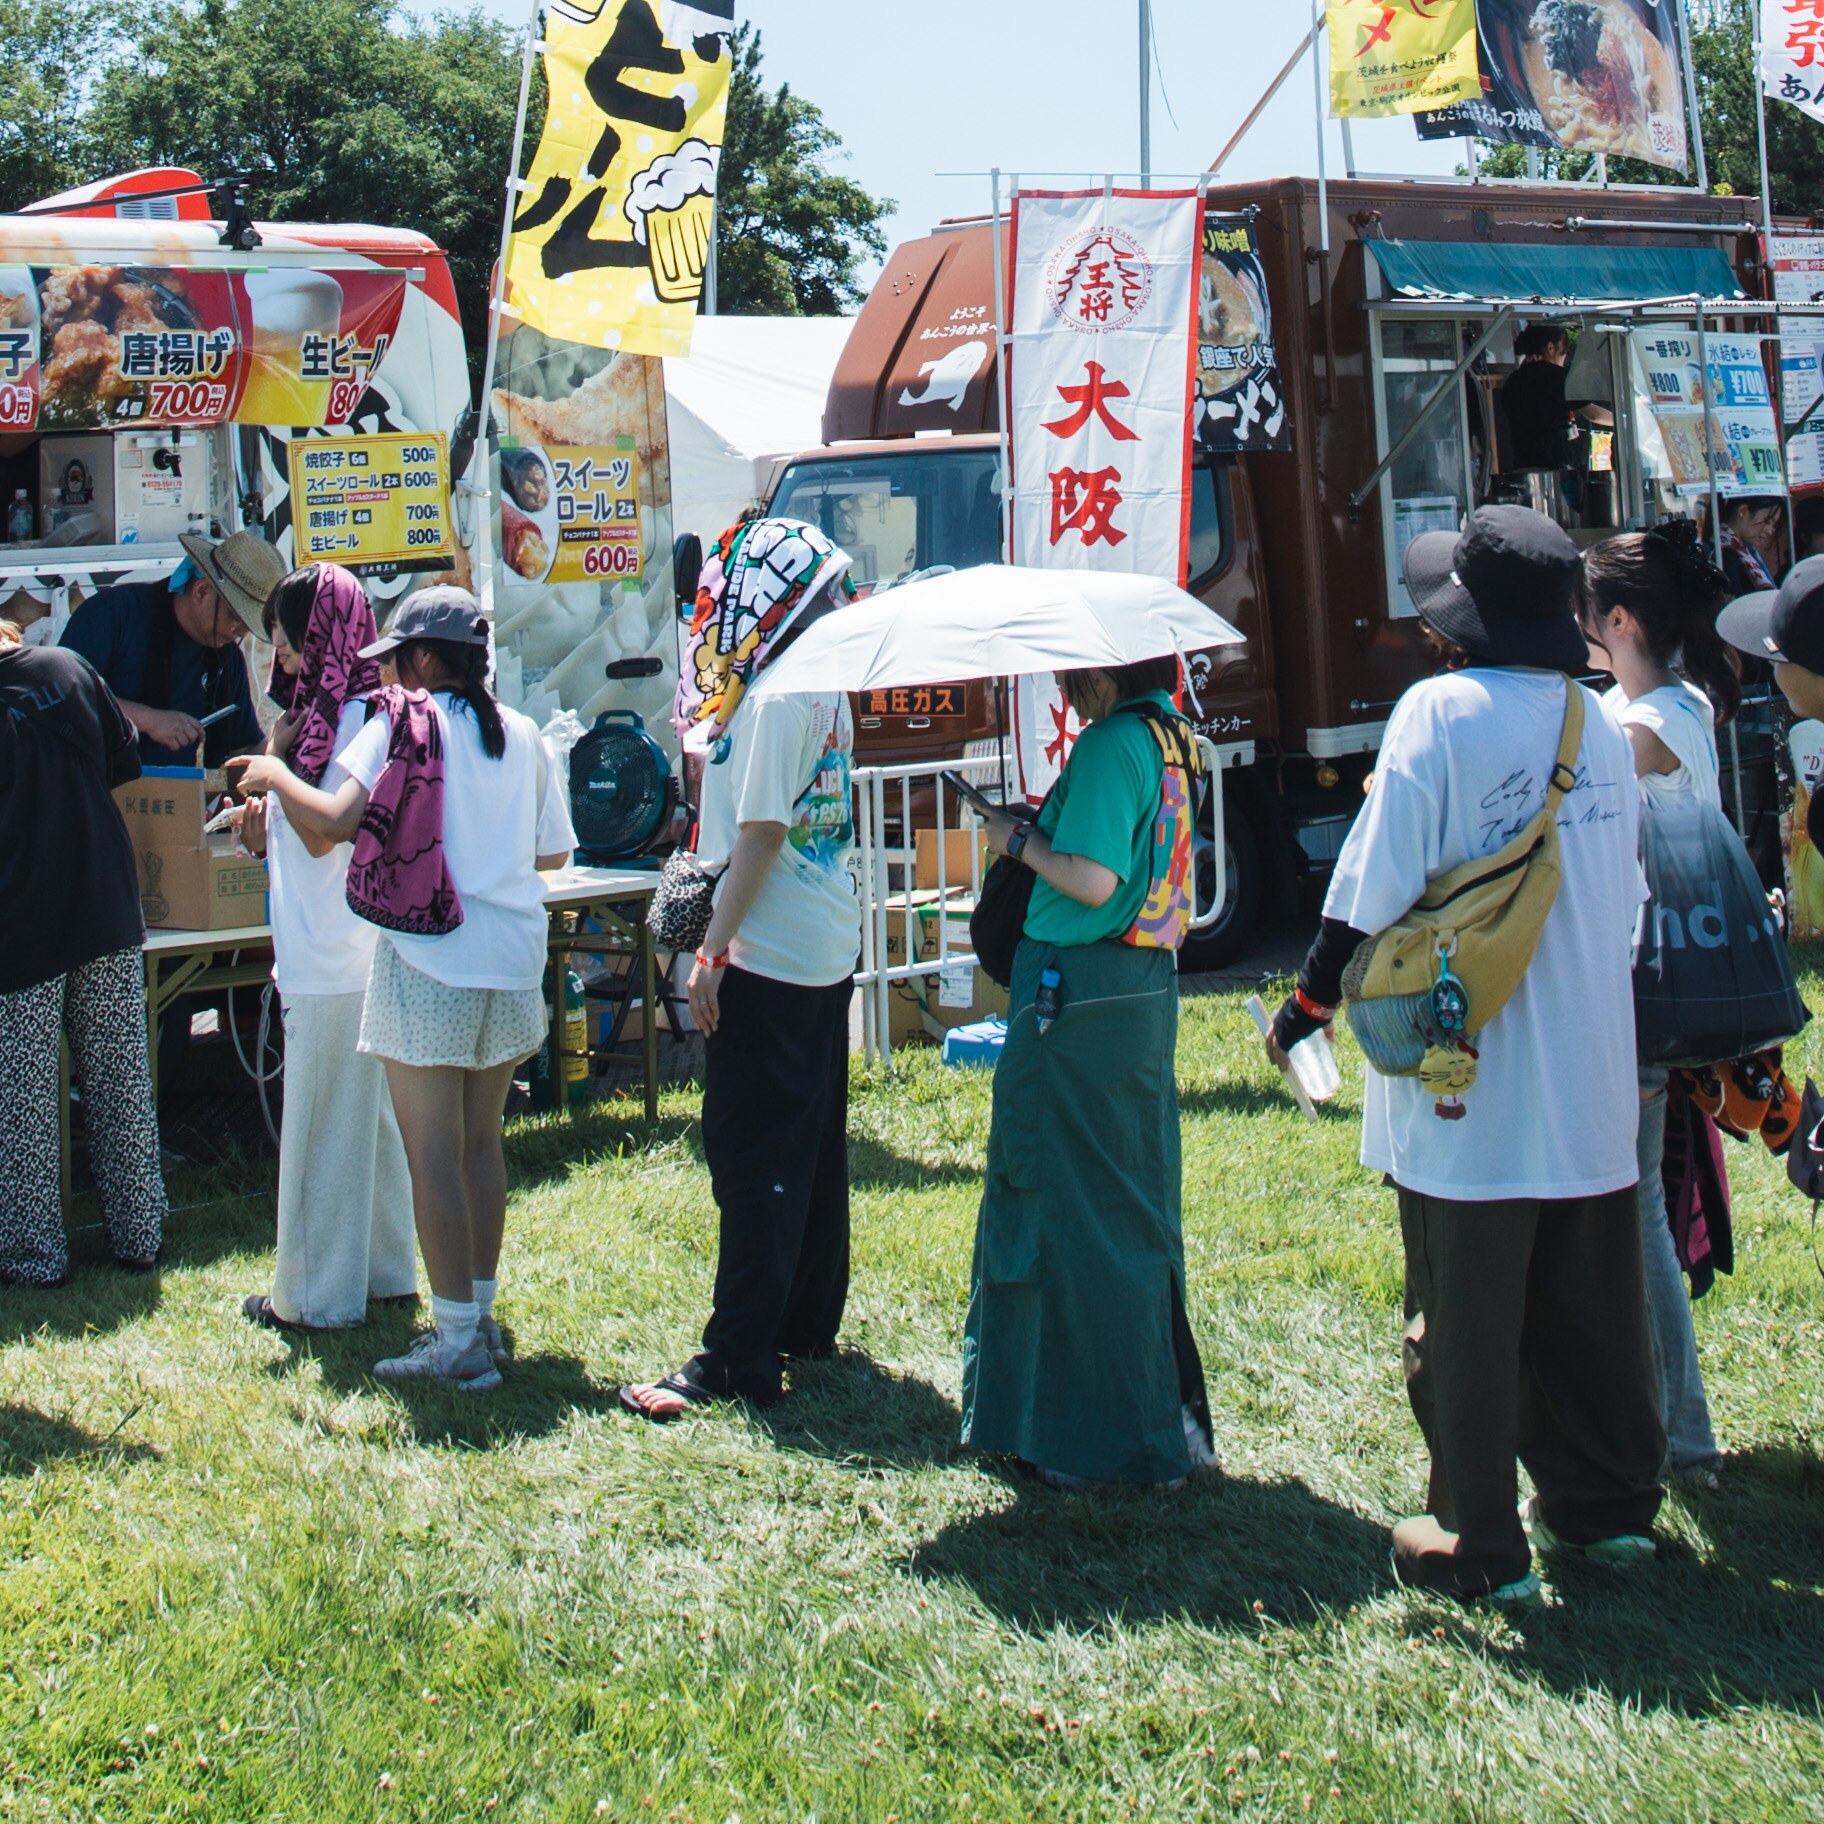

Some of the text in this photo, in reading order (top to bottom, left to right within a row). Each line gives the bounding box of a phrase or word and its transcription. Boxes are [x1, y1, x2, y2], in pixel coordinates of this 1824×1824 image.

[1080, 261, 1114, 321] 王将
[950, 306, 987, 320] ようこそ
[920, 323, 998, 340] あんこうの世界へ
[121, 333, 232, 377] 唐揚げ
[1645, 340, 1691, 358] 一番搾り
[1649, 372, 1681, 393] ¥800
[1730, 370, 1764, 394] ¥700
[116, 400, 143, 416] 4個
[150, 383, 224, 417] 700円
[305, 451, 345, 469] 焼餃子
[403, 447, 436, 463] 500円
[307, 474, 380, 492] スイーツロール
[405, 471, 438, 487] 600円
[555, 460, 630, 489] スイーツ
[309, 510, 348, 527] 唐揚げ
[406, 504, 440, 520] 700円
[557, 492, 612, 520] ロール
[311, 528, 441, 552] 生ビール 800円
[584, 545, 638, 574] 600円
[719, 598, 738, 653] PARK
[870, 689, 955, 713] 高圧ガス
